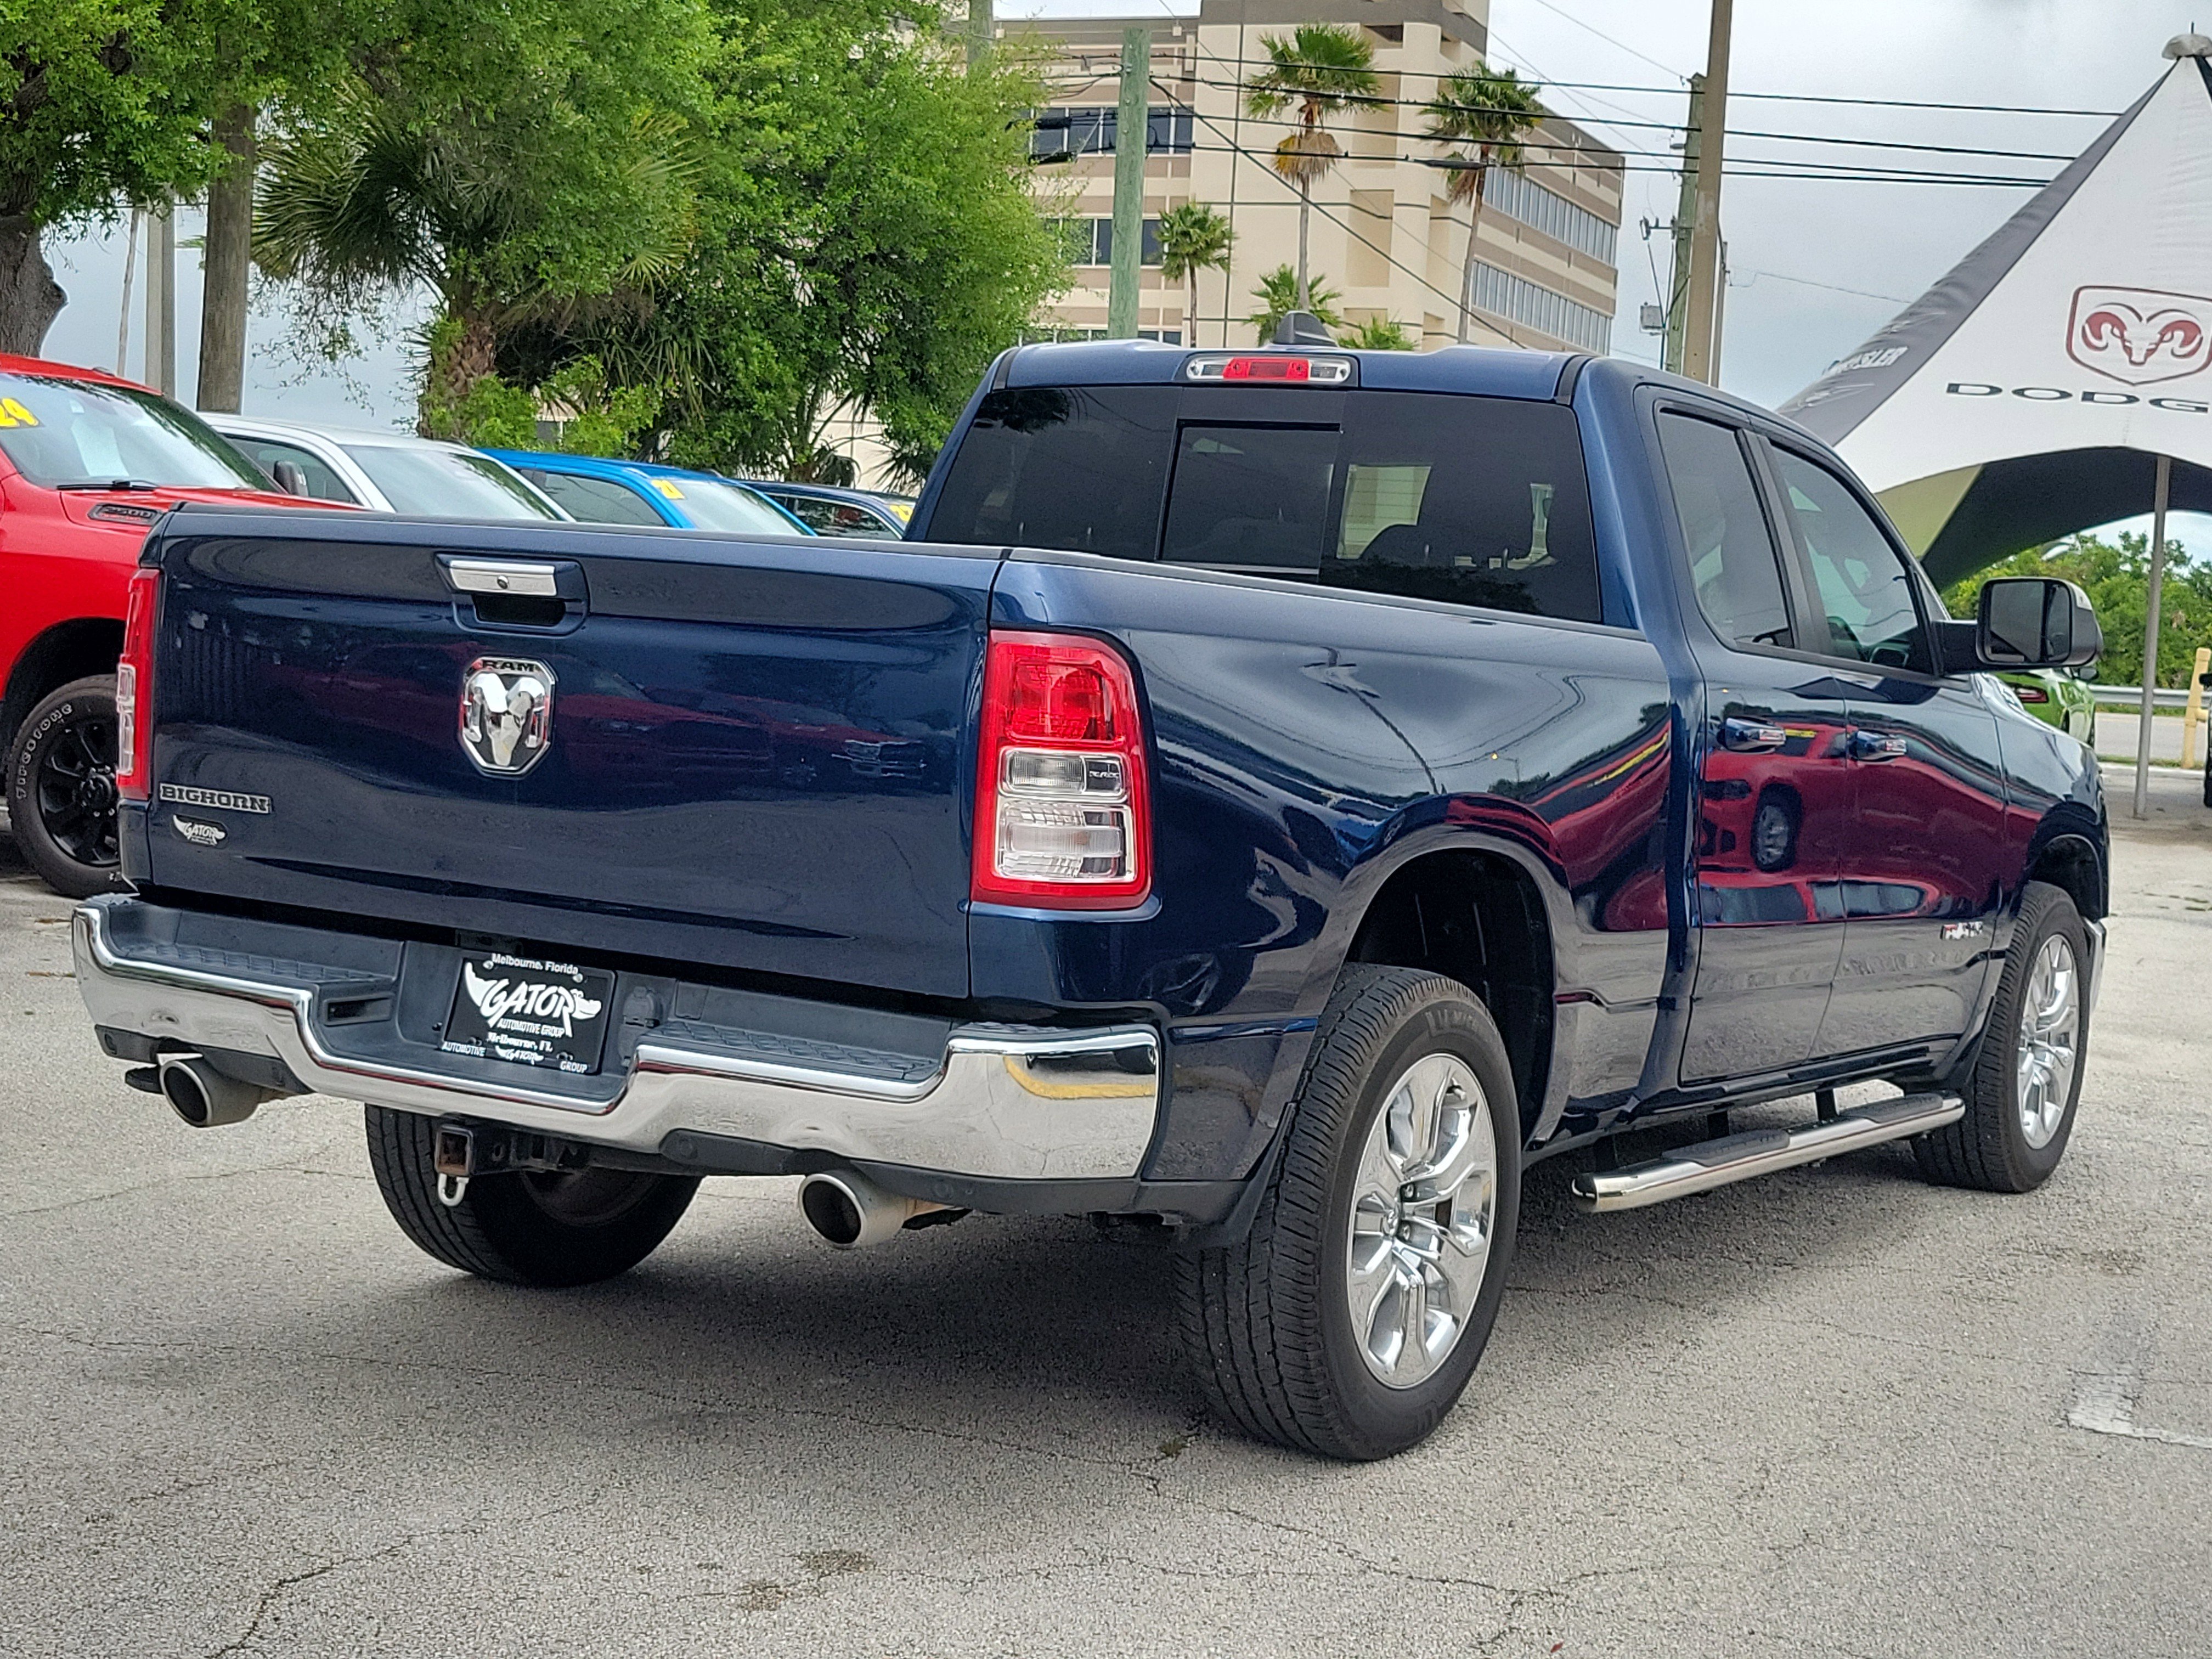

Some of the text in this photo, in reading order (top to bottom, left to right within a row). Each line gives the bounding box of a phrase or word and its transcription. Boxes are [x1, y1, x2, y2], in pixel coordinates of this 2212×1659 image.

[1946, 382, 2210, 414] DODG
[482, 660, 535, 672] RAM
[161, 785, 268, 812] BIGHORN
[545, 961, 579, 975] Florida
[479, 978, 573, 1038] GATOR
[497, 1018, 565, 1039] AUTOMOTIVE GROUP
[442, 1042, 486, 1057] AUTOMOTIVE
[560, 1060, 588, 1074] GROUP
